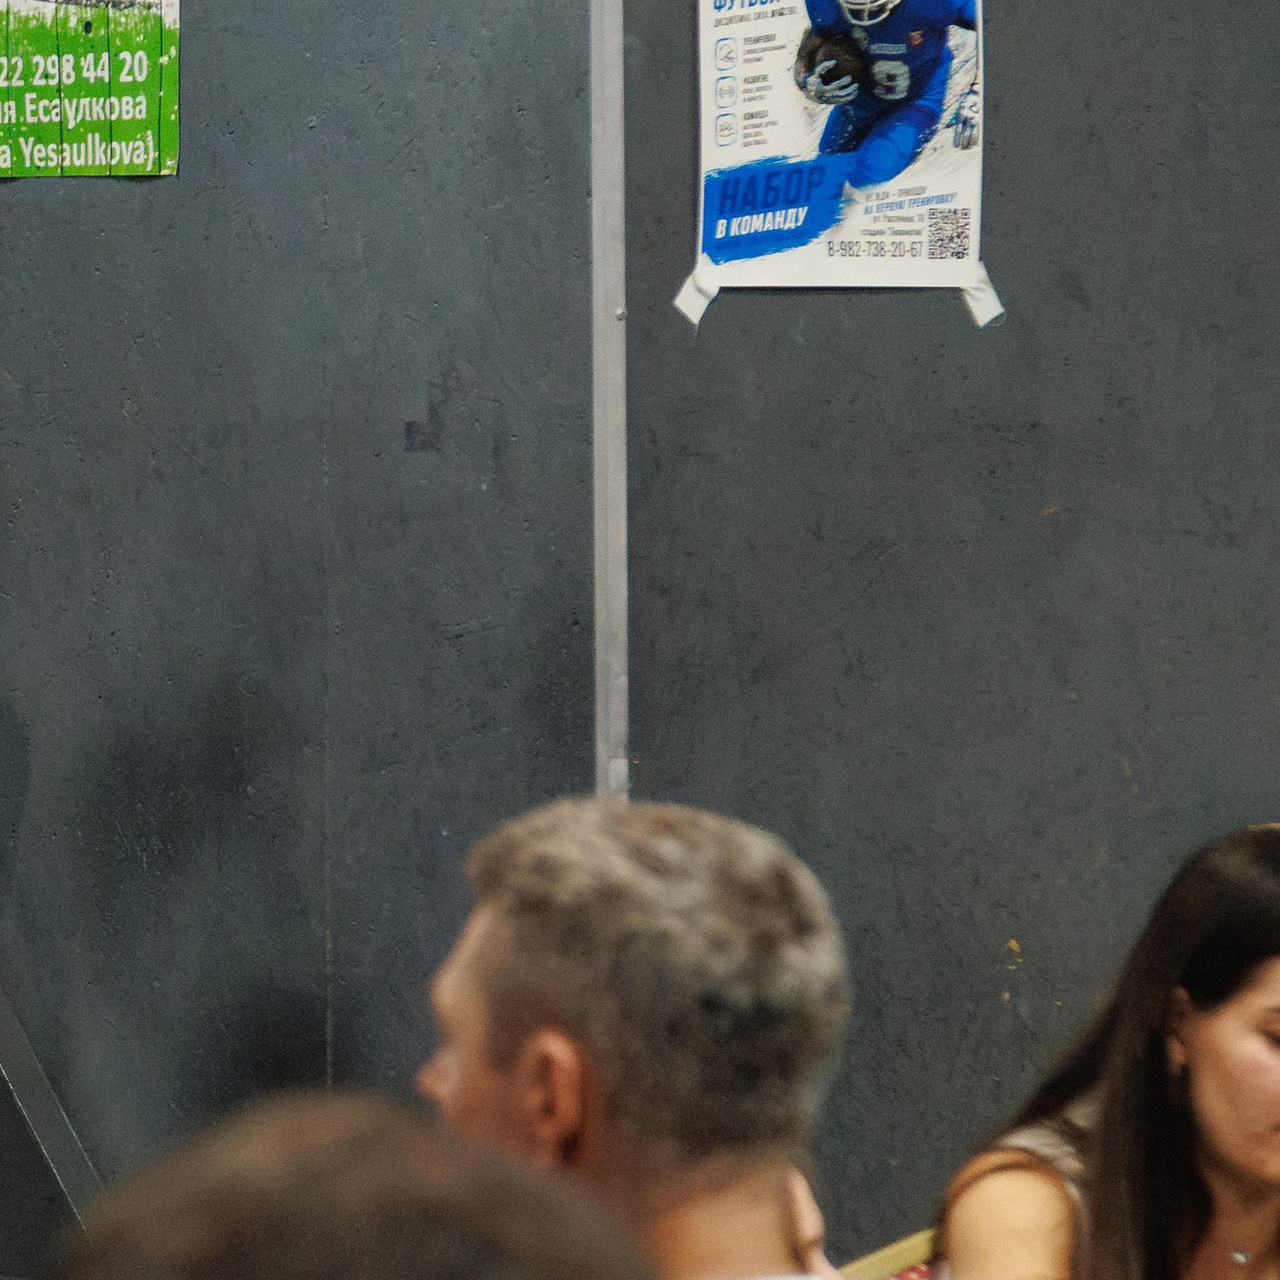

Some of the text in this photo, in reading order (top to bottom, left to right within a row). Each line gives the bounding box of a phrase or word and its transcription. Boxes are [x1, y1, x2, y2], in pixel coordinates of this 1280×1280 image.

[32, 54, 76, 86] 298
[82, 52, 110, 83] 44
[119, 50, 148, 82] 20
[25, 93, 147, 130] Есаулкова
[20, 130, 154, 171] Yesaulkova)
[720, 166, 826, 215] НАБОР
[715, 207, 809, 239] В КОМАНДУ
[828, 241, 923, 258] 8-982-738-20-67
